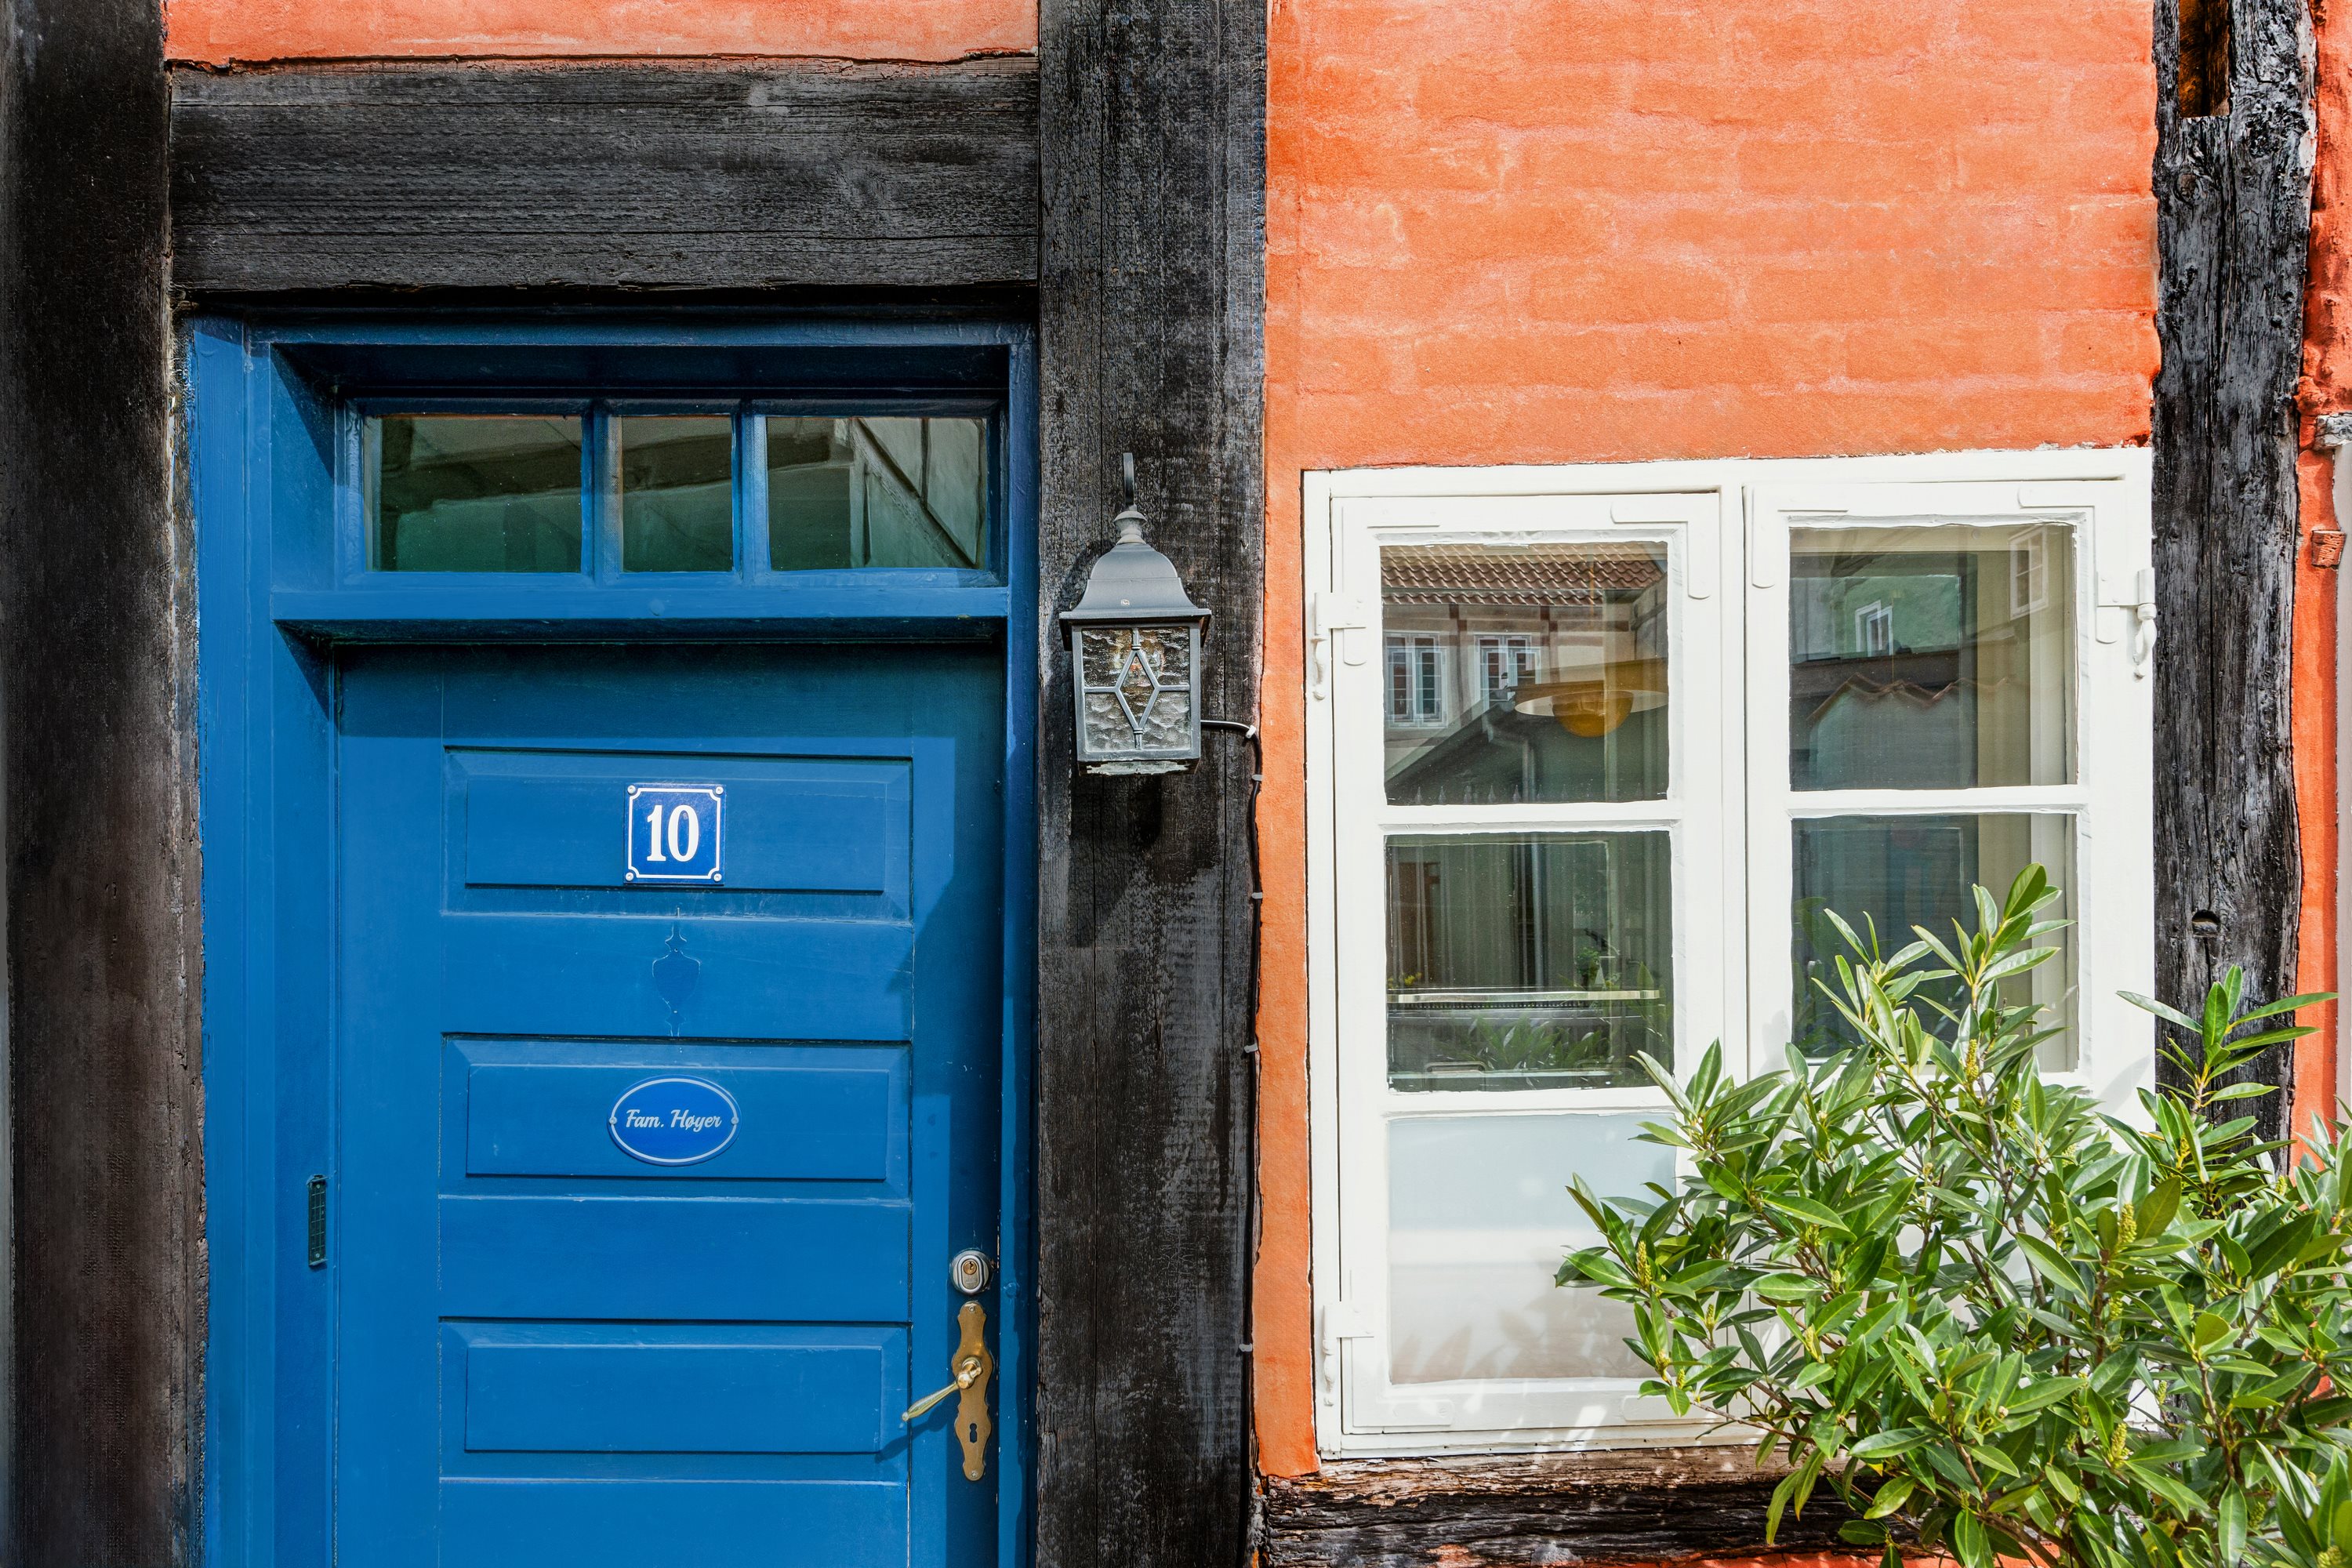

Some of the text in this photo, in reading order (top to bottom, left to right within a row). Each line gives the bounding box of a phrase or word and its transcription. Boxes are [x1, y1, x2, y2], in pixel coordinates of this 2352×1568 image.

[646, 804, 699, 862] 10
[626, 1109, 722, 1133] Fam. Høyer
